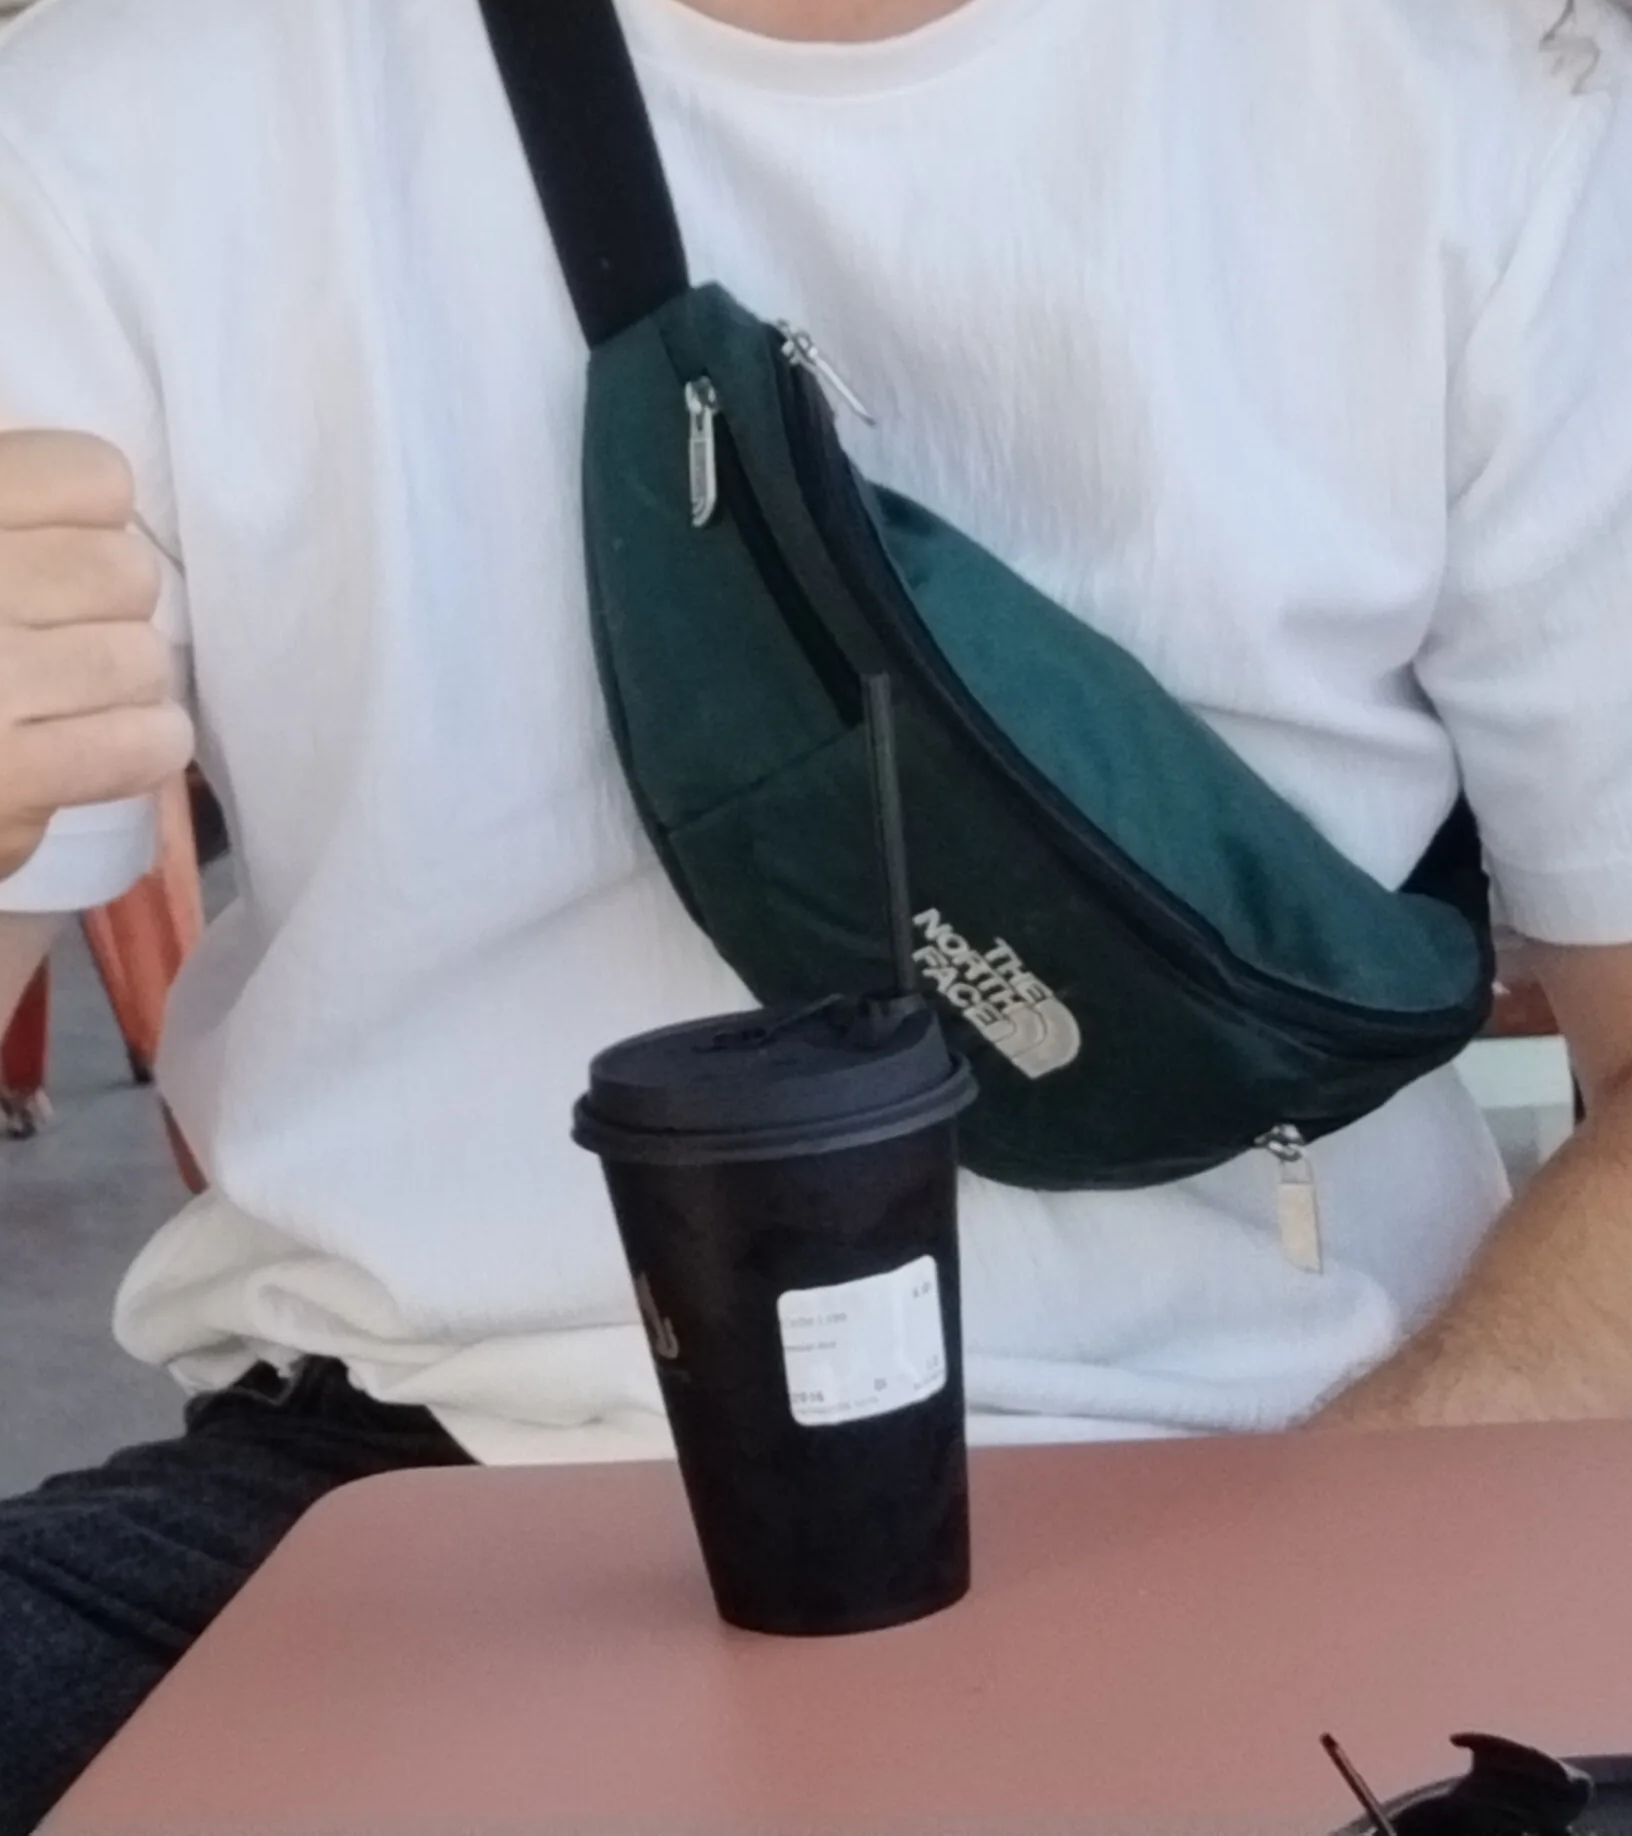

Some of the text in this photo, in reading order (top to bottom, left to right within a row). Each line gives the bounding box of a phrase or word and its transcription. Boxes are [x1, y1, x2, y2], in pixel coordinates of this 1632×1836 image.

[911, 945, 1004, 1030] FACE
[912, 907, 1032, 1016] NORTH
[985, 936, 1054, 1006] THE
